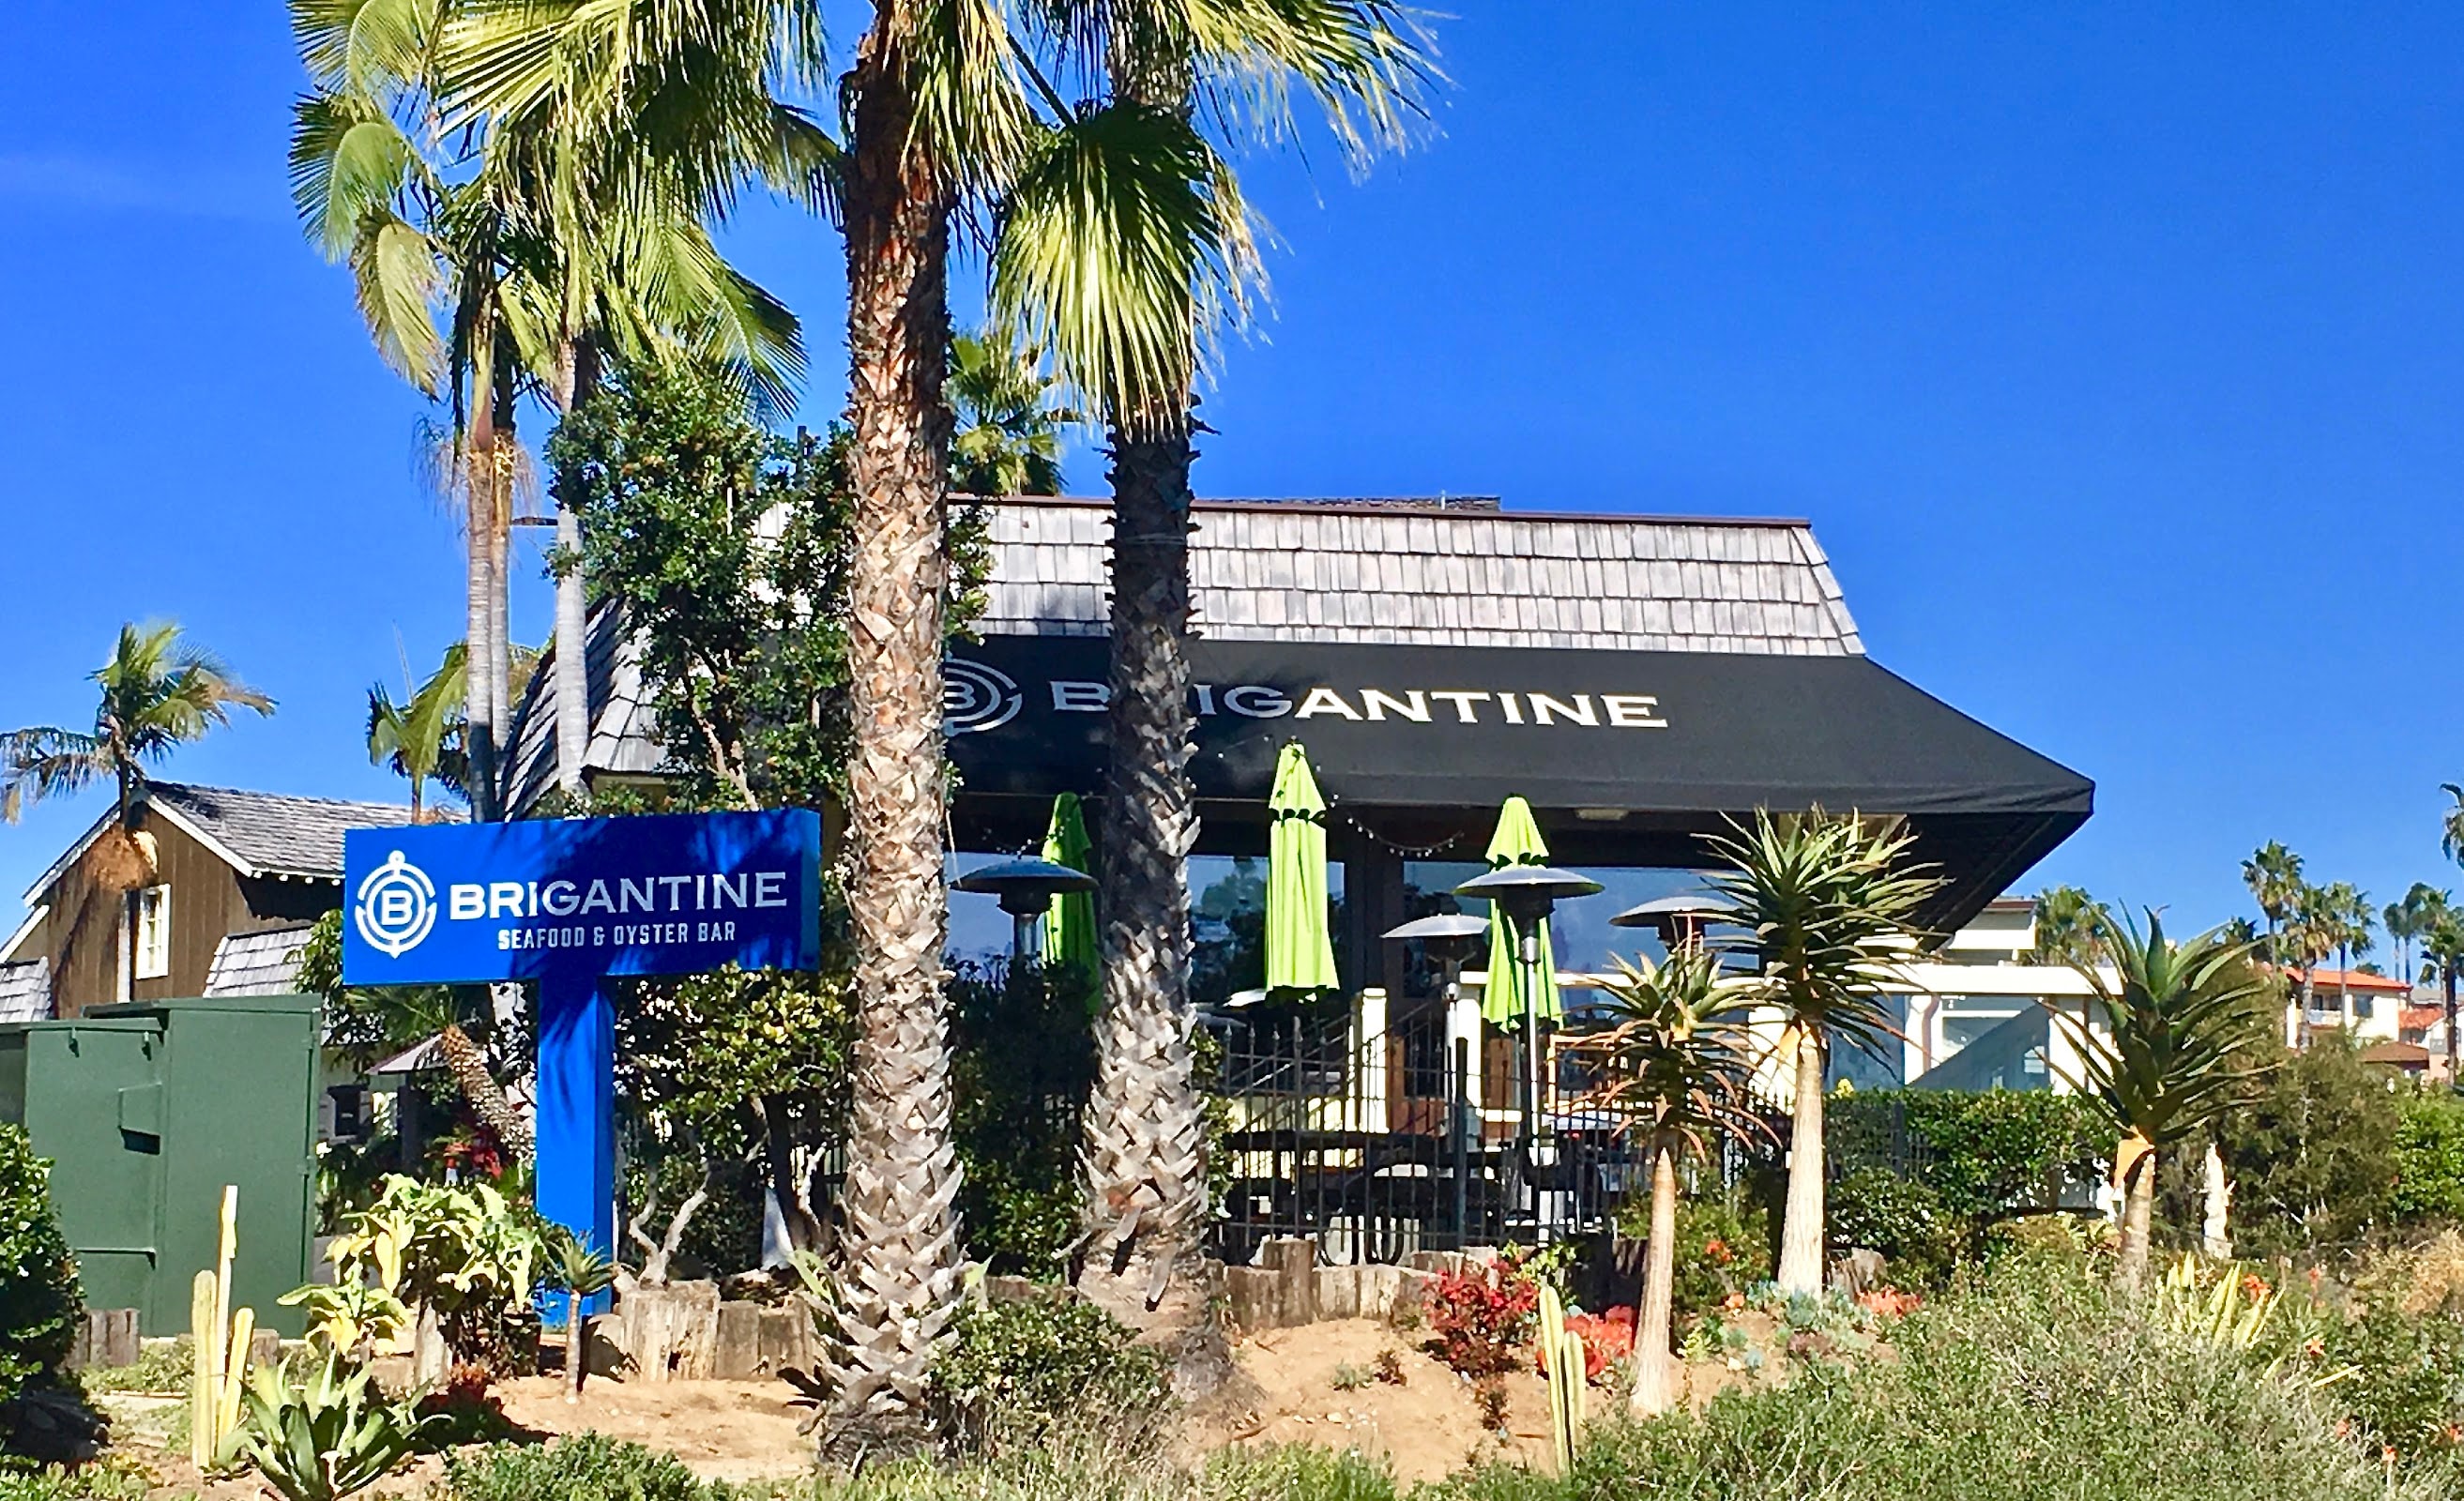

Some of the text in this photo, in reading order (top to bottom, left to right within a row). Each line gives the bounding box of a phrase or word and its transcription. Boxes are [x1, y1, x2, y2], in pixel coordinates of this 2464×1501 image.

[1050, 680, 1668, 728] BIGANTINE
[381, 889, 413, 926] B
[449, 872, 787, 920] BRIGANTINE
[497, 921, 736, 950] SEAFOOD & OYSTER BAR
